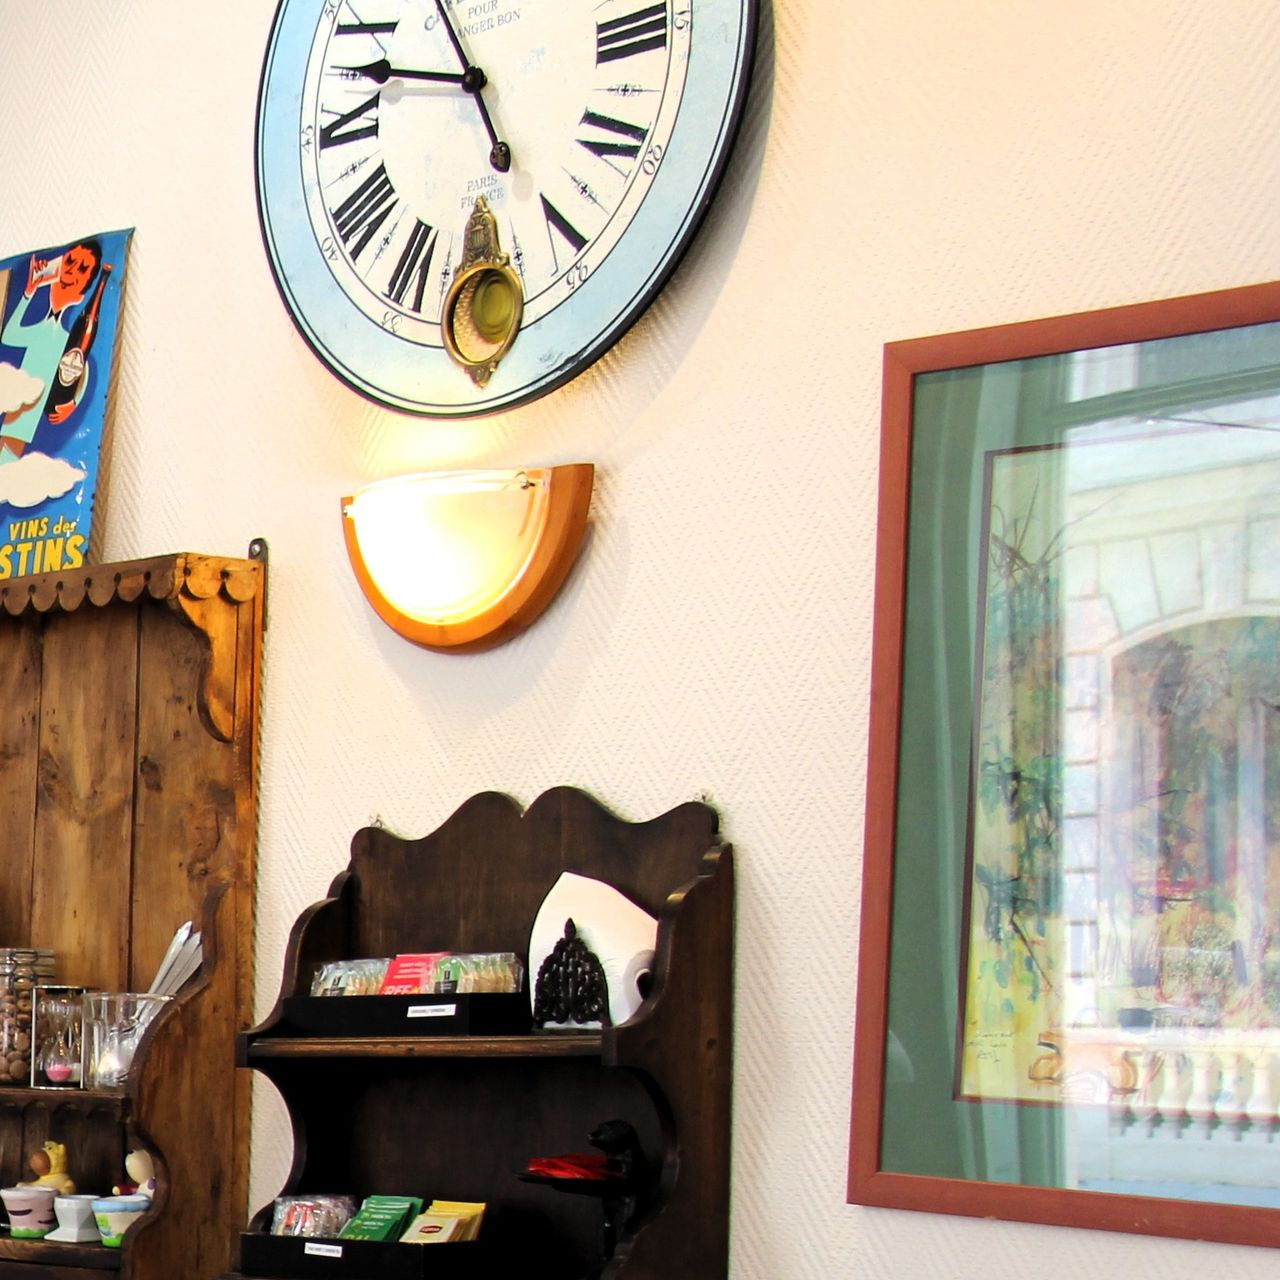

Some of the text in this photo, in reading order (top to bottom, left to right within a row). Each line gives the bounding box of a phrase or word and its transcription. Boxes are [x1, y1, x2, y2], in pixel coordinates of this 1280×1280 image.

[467, 0, 498, 18] POUR
[447, 9, 522, 43] ANGER BON
[301, 125, 314, 154] 45
[642, 143, 663, 176] 20
[466, 174, 499, 192] PARIS
[460, 187, 505, 209] FRNCE
[321, 235, 339, 262] 40
[9, 514, 78, 542] VINS des
